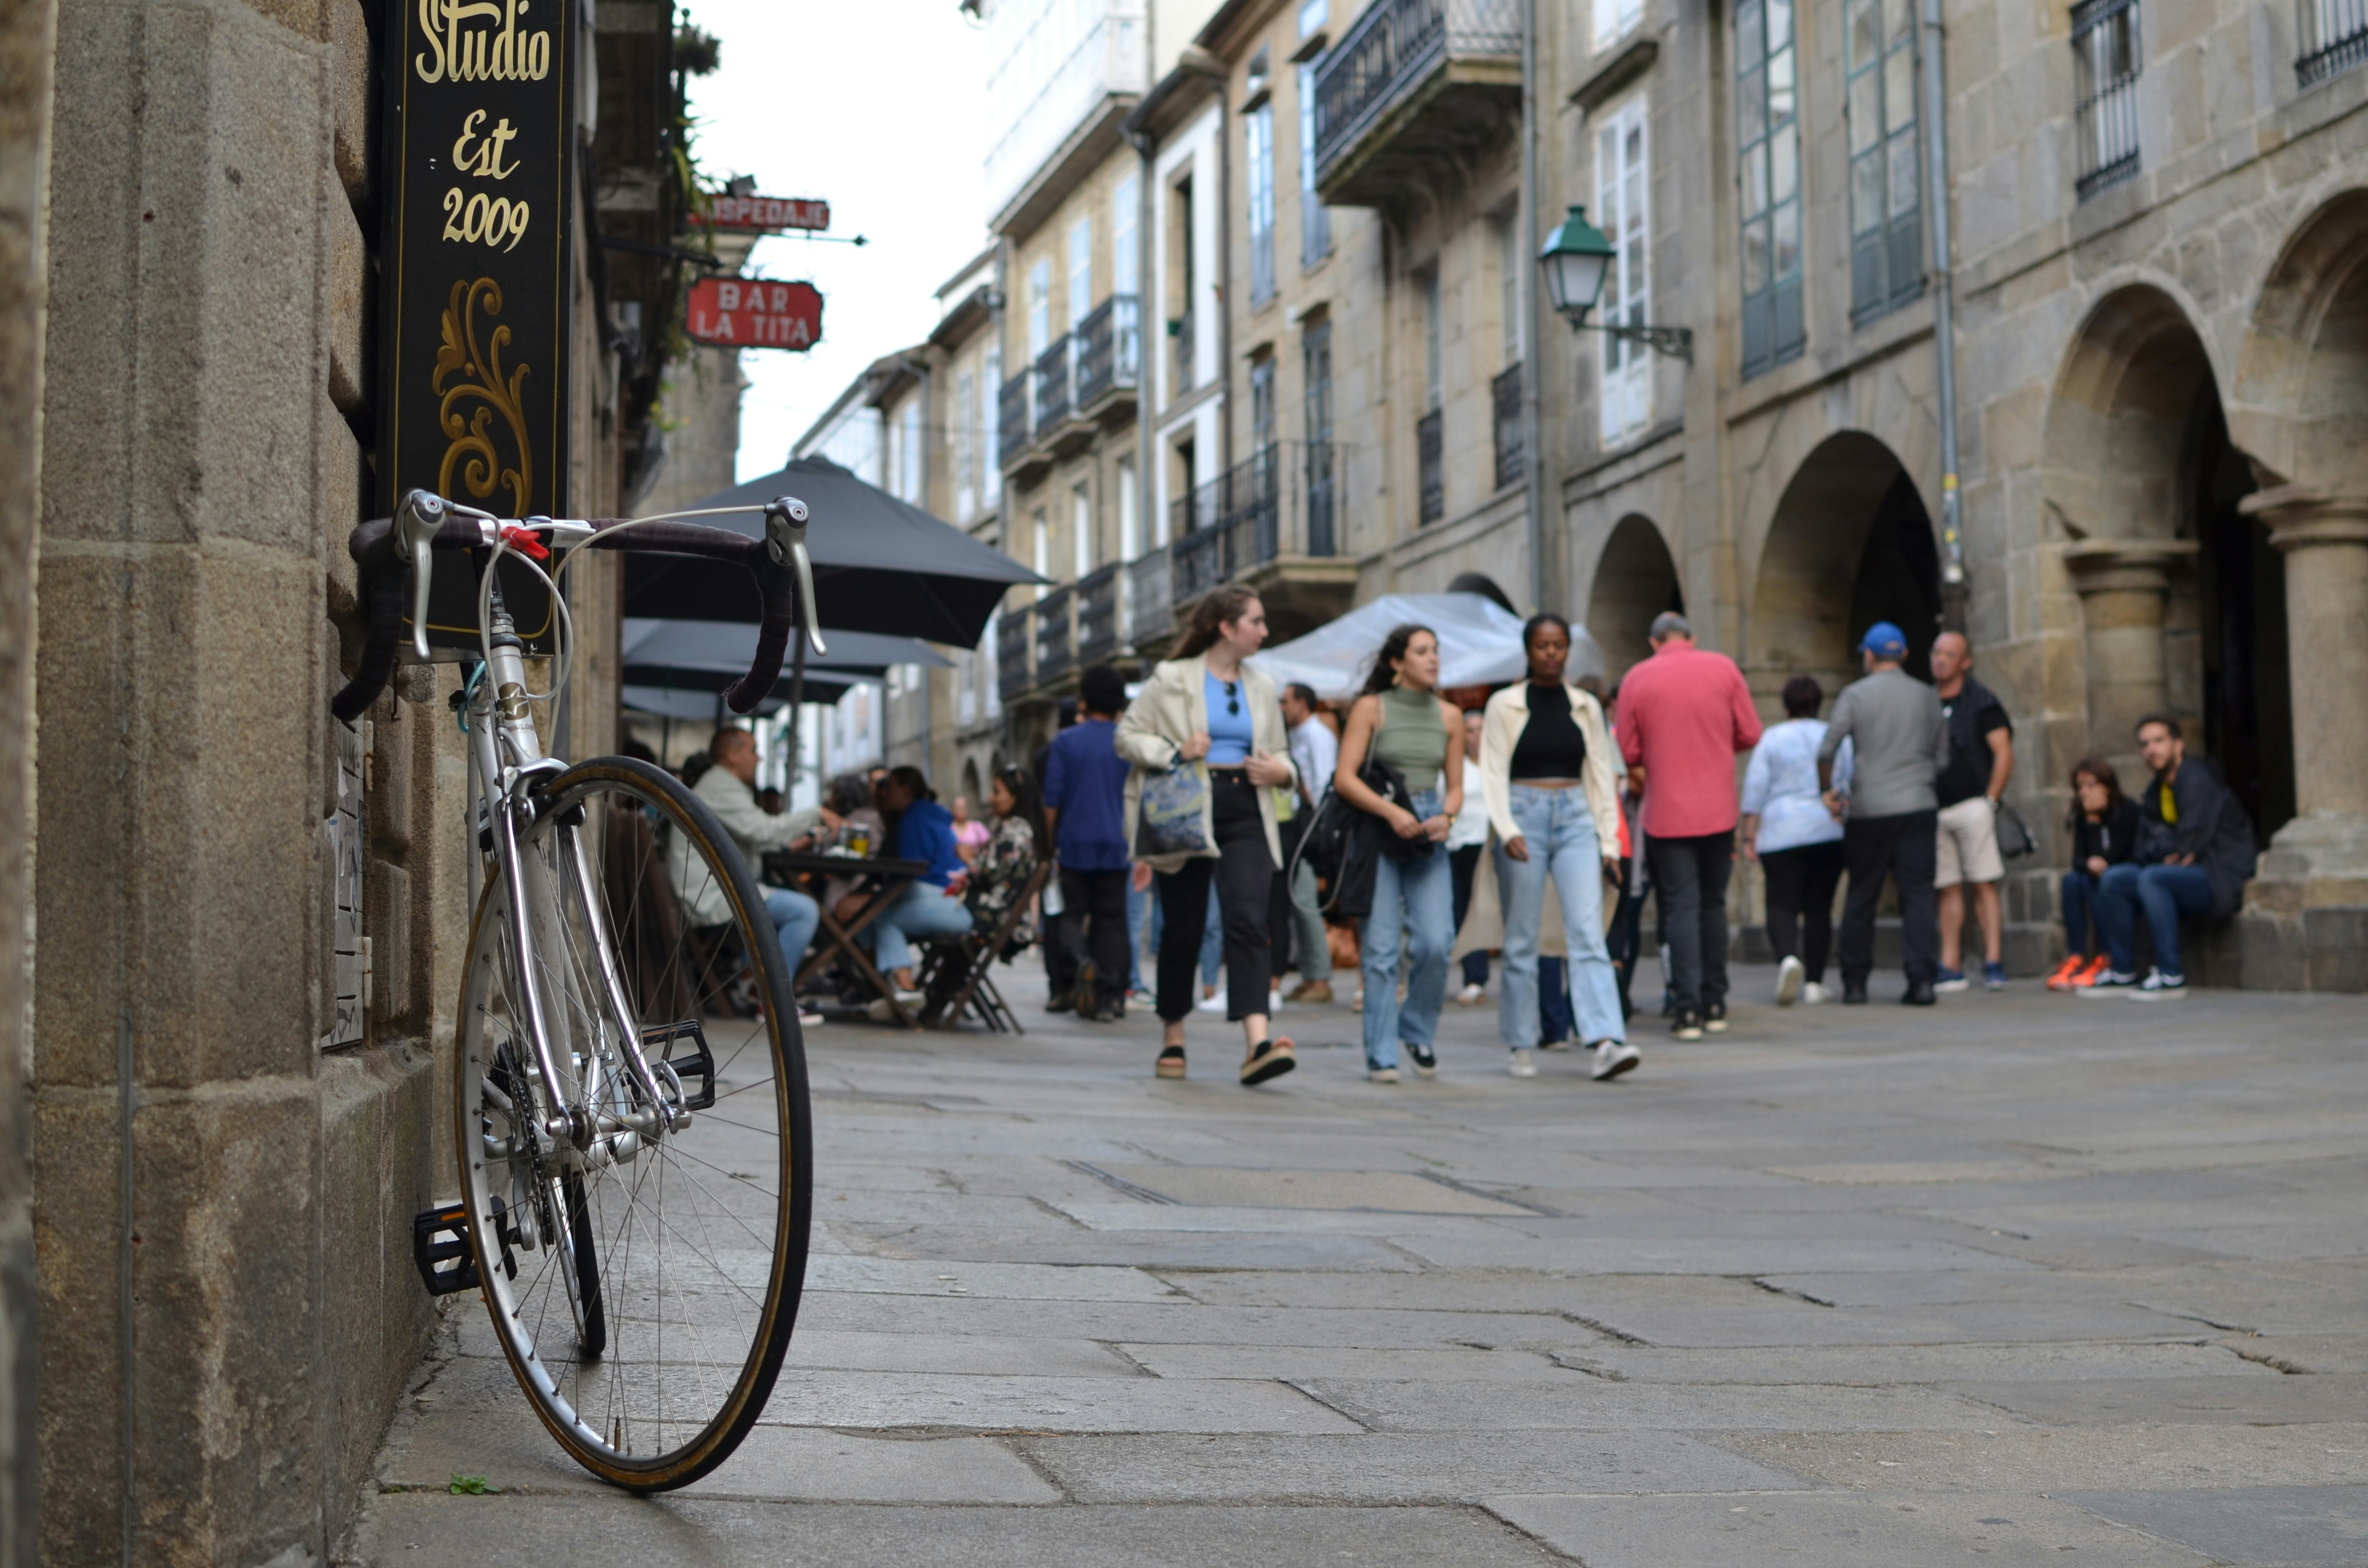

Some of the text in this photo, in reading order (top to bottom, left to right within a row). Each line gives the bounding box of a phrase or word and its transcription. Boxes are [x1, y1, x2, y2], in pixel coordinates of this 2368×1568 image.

[416, 0, 549, 83] Studio
[453, 109, 520, 180] Est
[443, 187, 529, 253] 2009
[692, 196, 827, 227] SPEDAJE
[718, 282, 788, 313] BAR
[697, 310, 811, 344] LA TITA
